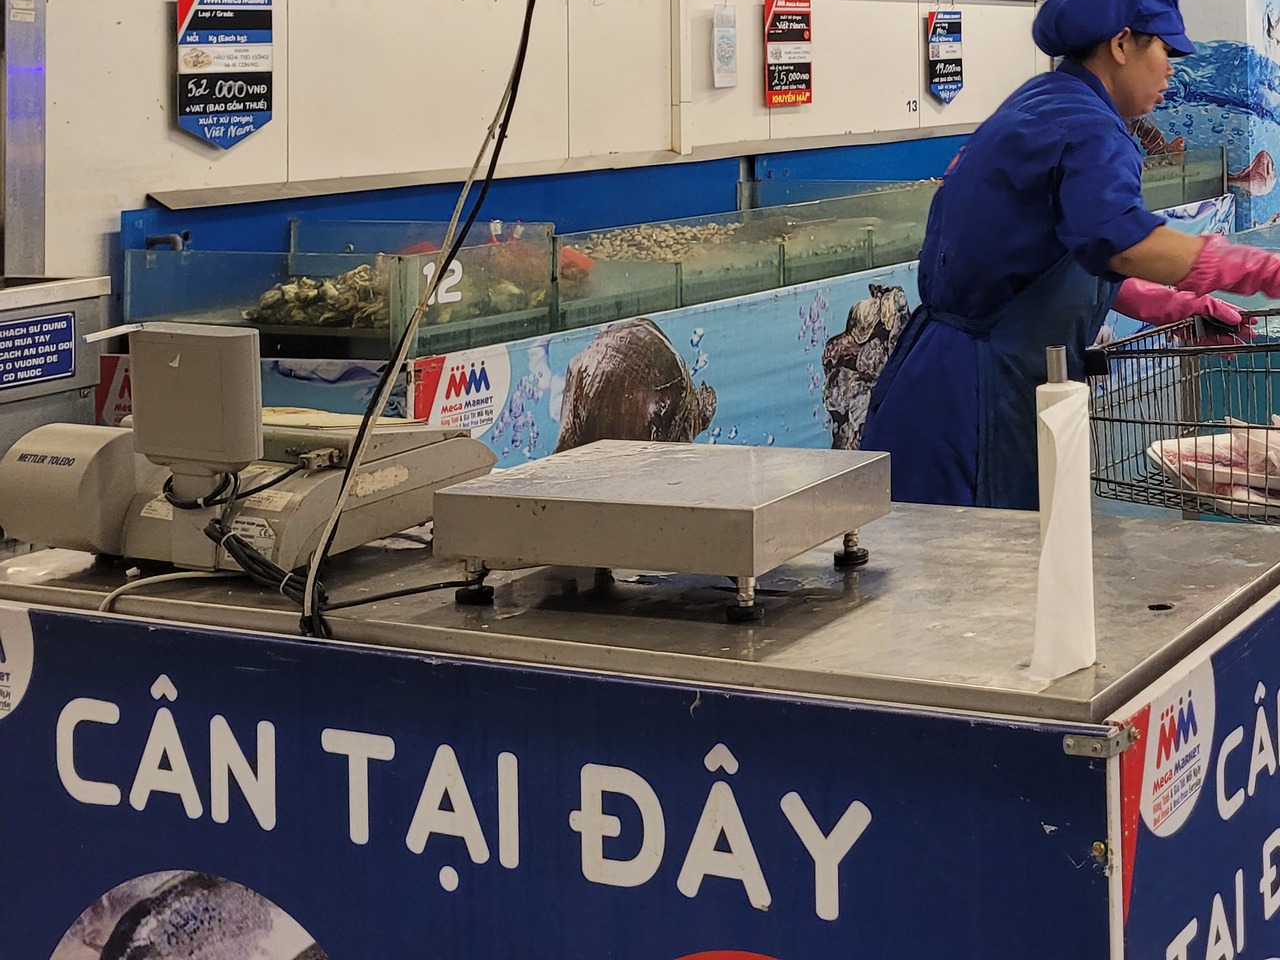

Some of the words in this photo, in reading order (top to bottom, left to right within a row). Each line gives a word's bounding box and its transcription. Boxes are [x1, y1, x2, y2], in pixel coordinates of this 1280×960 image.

[247, 84, 268, 94] VNĐ
[772, 91, 796, 103] KHUYẾN
[185, 104, 205, 113] +VAT
[206, 103, 225, 113] (BAO
[906, 100, 918, 113] 13
[198, 115, 217, 125] XUẤT
[227, 124, 256, 138] Nam
[422, 259, 463, 305] 12
[34, 334, 51, 344] TAY
[3, 372, 15, 382] CO
[16, 453, 48, 465] METTLER
[49, 455, 76, 467] TOLEDO
[56, 673, 277, 831] CÂN
[321, 727, 519, 892] TẠI
[569, 743, 872, 921] ĐÂY
